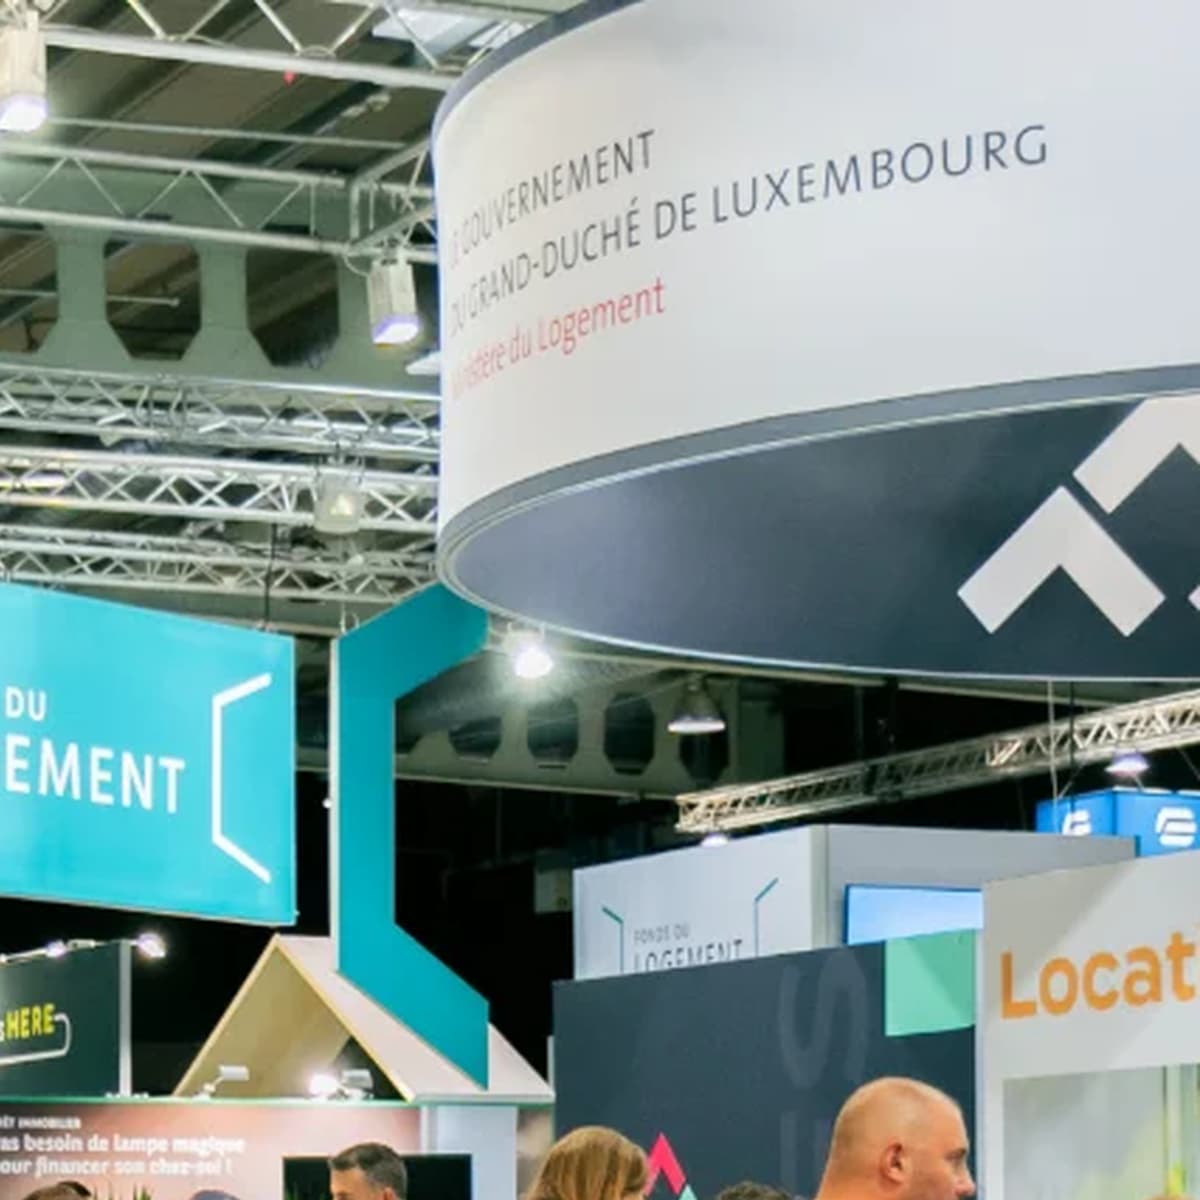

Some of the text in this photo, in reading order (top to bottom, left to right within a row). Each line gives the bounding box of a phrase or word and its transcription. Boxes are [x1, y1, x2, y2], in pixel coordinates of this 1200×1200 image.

[462, 129, 655, 256] GOUVERNEMENT
[469, 195, 641, 319] GRAND-DUCHÉ
[654, 191, 697, 241] DE
[713, 124, 1048, 224] LUXEMBOURG
[510, 326, 533, 364] du
[538, 277, 665, 356] Logement
[5, 685, 47, 722] DU
[1000, 930, 1200, 1021] Locat
[5, 1003, 56, 1040] HERE
[23, 1133, 84, 1152] besoin
[87, 1133, 110, 1152] de
[113, 1134, 169, 1157] lampe
[171, 1136, 245, 1159] magique
[34, 1157, 110, 1178] financer
[114, 1161, 145, 1175] son
[149, 1158, 221, 1176] chez-soi
